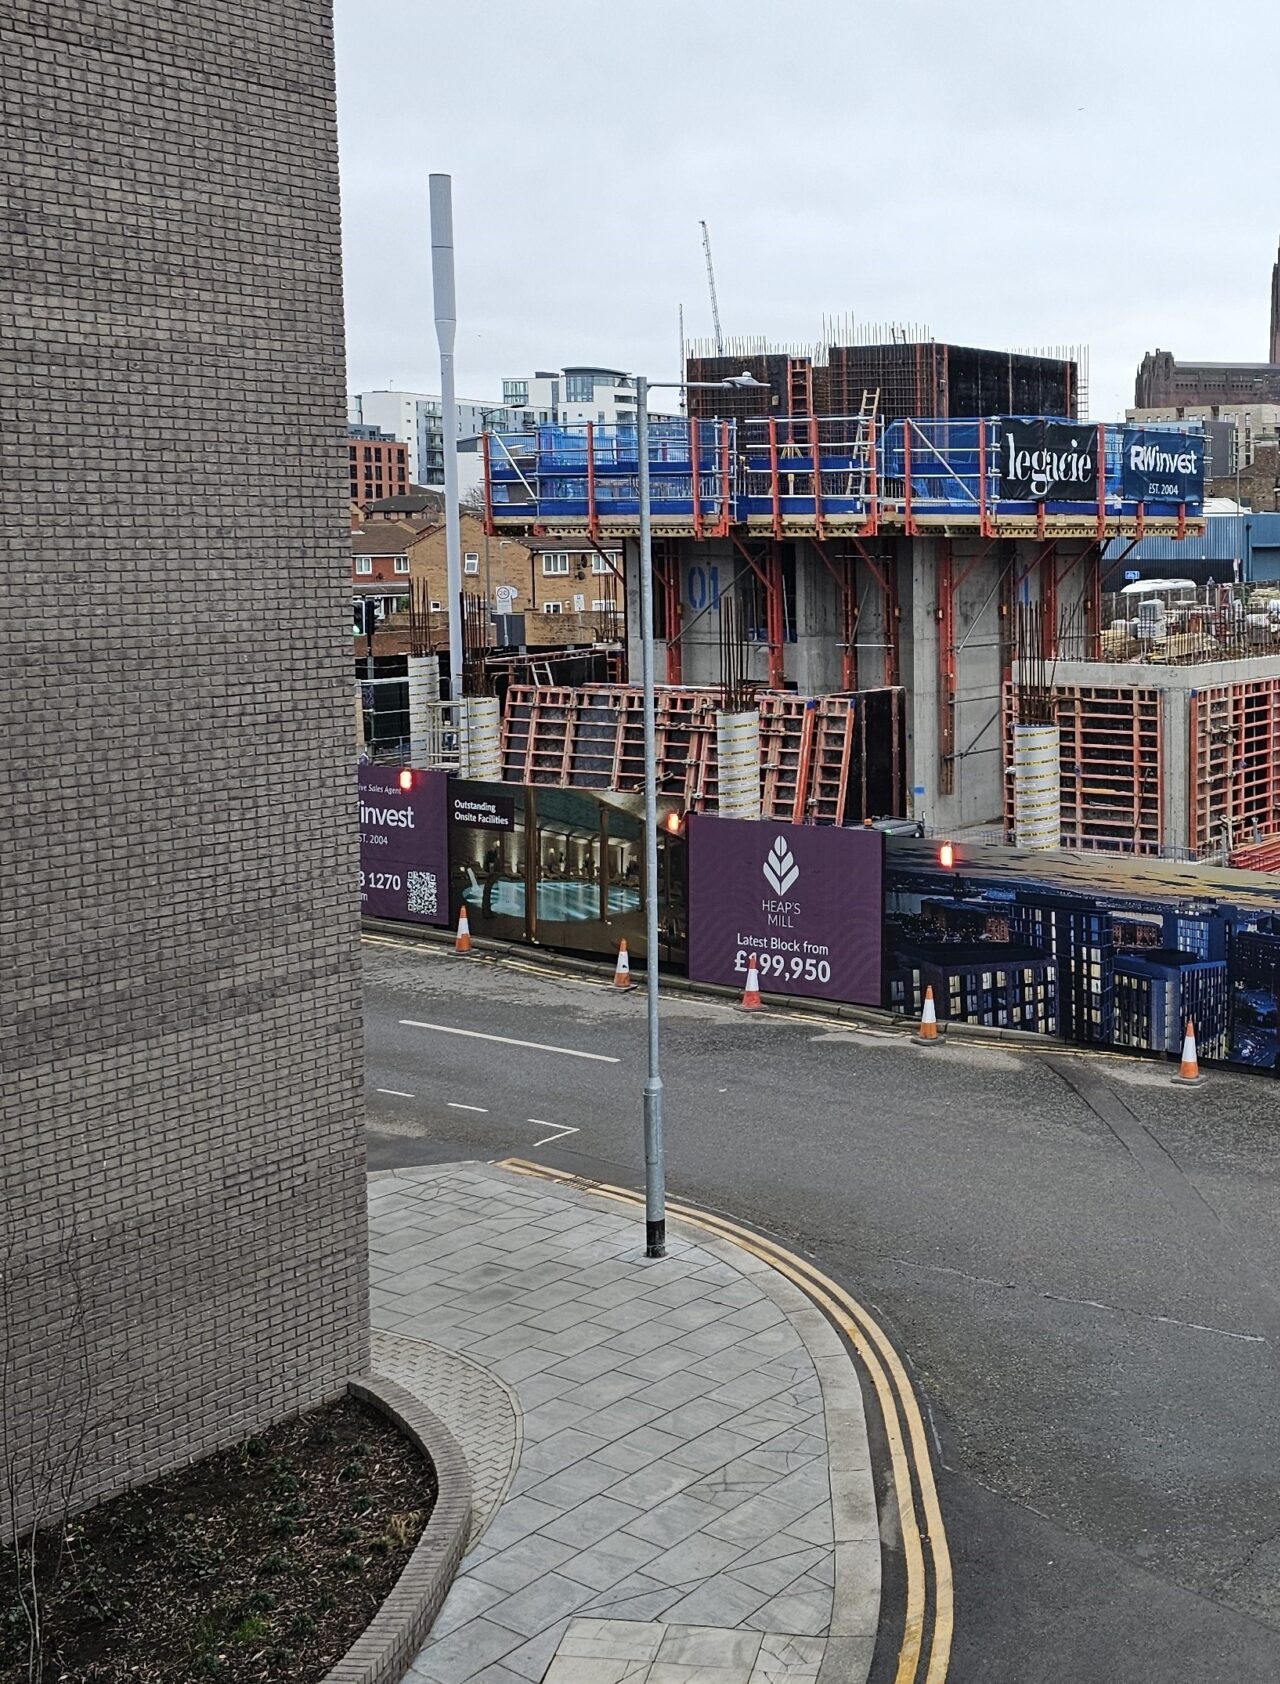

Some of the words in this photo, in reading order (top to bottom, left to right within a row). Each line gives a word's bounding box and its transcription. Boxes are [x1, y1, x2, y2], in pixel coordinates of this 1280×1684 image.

[1005, 432, 1092, 495] legacie
[1130, 445, 1198, 475] RWinvest
[1148, 483, 1160, 494] EST.
[1161, 484, 1179, 496] 2004
[368, 784, 383, 793] Sales
[384, 785, 402, 795] Agent
[454, 799, 496, 813] Outstanding
[360, 800, 415, 828] invest
[454, 811, 477, 822] Onsite
[478, 813, 509, 825] Facilities
[370, 835, 388, 845] 2004
[368, 872, 401, 891] 1270
[762, 899, 801, 915] HEAP'S
[767, 914, 794, 928] MILL
[737, 932, 768, 948] Latest
[770, 937, 800, 952] Block
[803, 941, 829, 956] from
